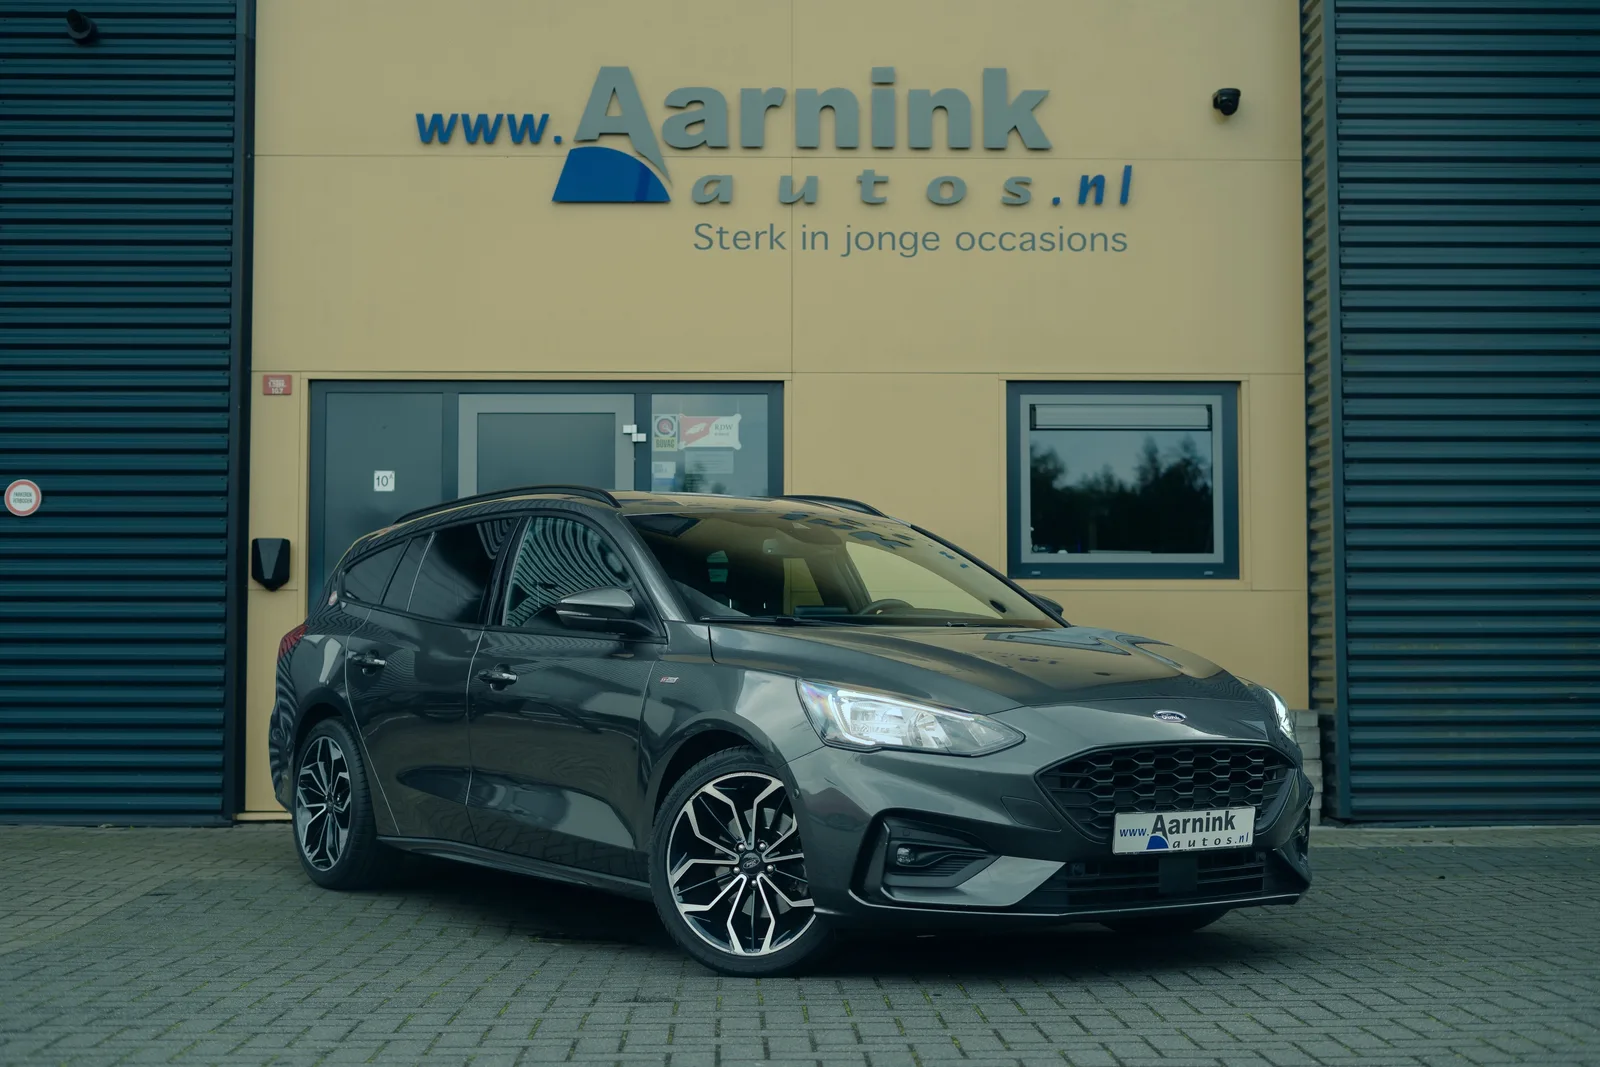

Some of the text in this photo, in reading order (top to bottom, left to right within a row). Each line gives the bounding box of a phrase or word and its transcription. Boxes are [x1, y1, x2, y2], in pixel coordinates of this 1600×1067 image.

[693, 223, 1128, 258] Sterk in jonge occasions
